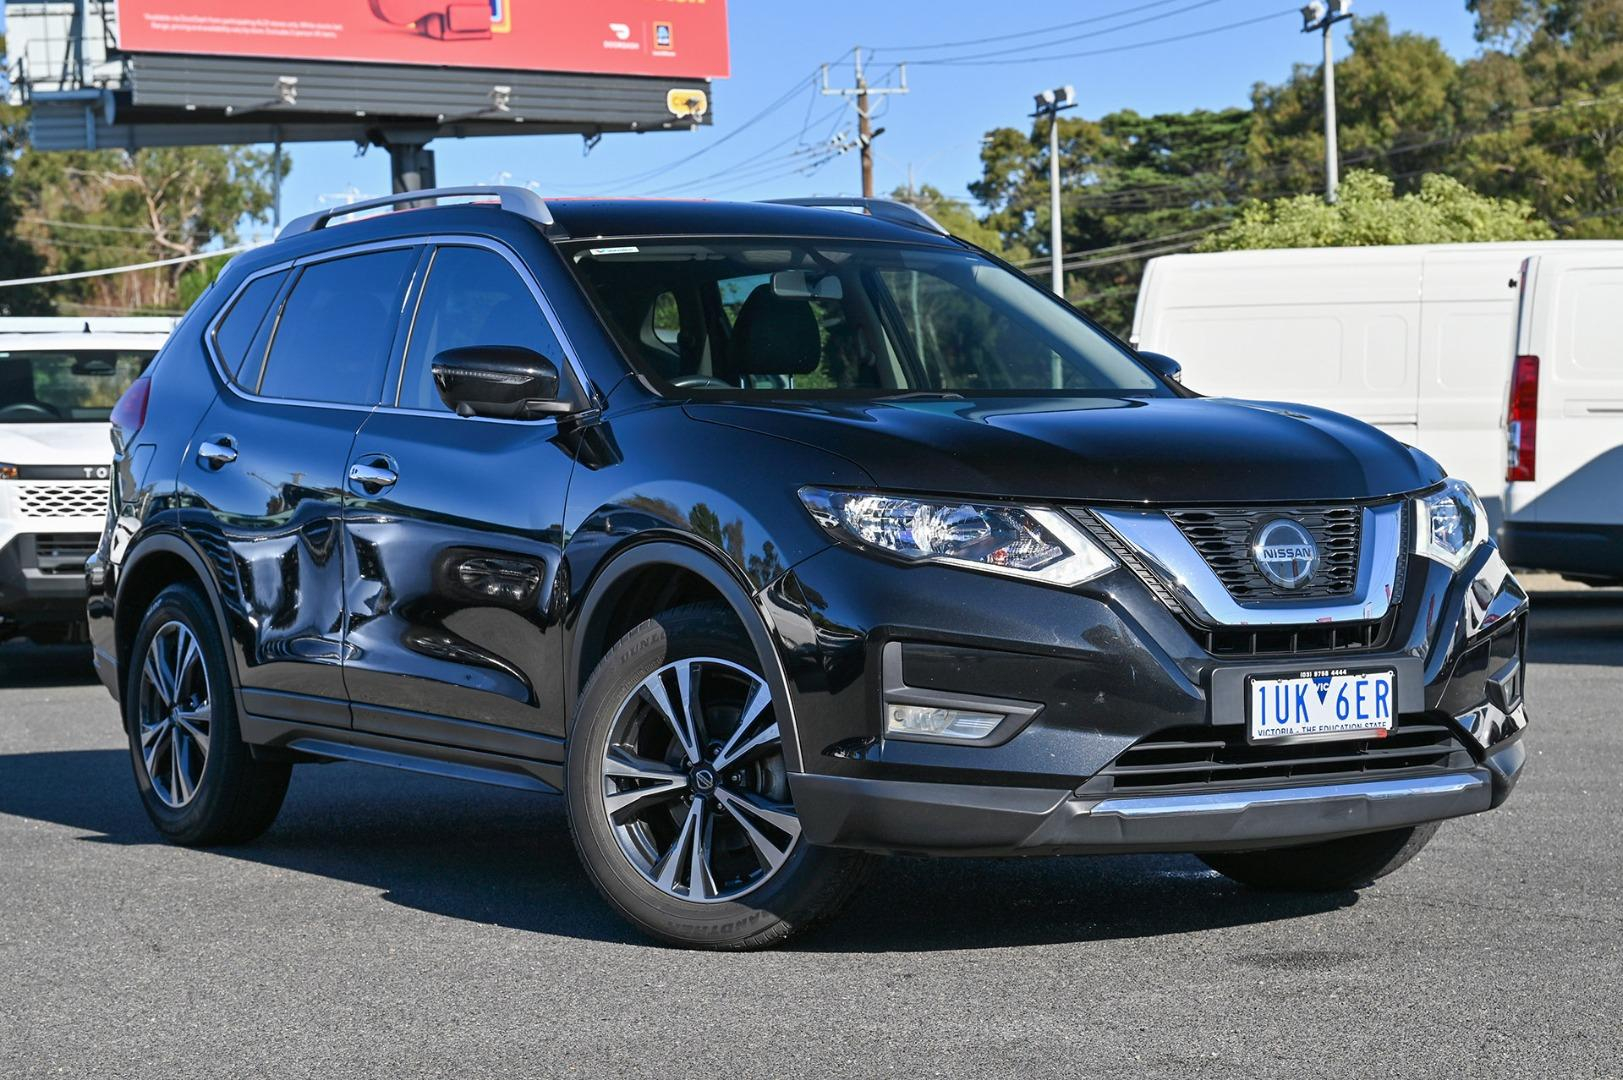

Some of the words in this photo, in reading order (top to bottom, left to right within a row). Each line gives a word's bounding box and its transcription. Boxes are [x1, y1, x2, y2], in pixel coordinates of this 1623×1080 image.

[1263, 548, 1311, 559] NISSAN
[1315, 682, 1330, 692] VIC
[1259, 683, 1309, 726] 1UK
[1335, 679, 1389, 721] 6ER
[1257, 727, 1294, 737] VICTORIA
[1302, 726, 1317, 734] THE
[1319, 723, 1362, 732] EDUCATION
[1364, 722, 1387, 730] STATE
